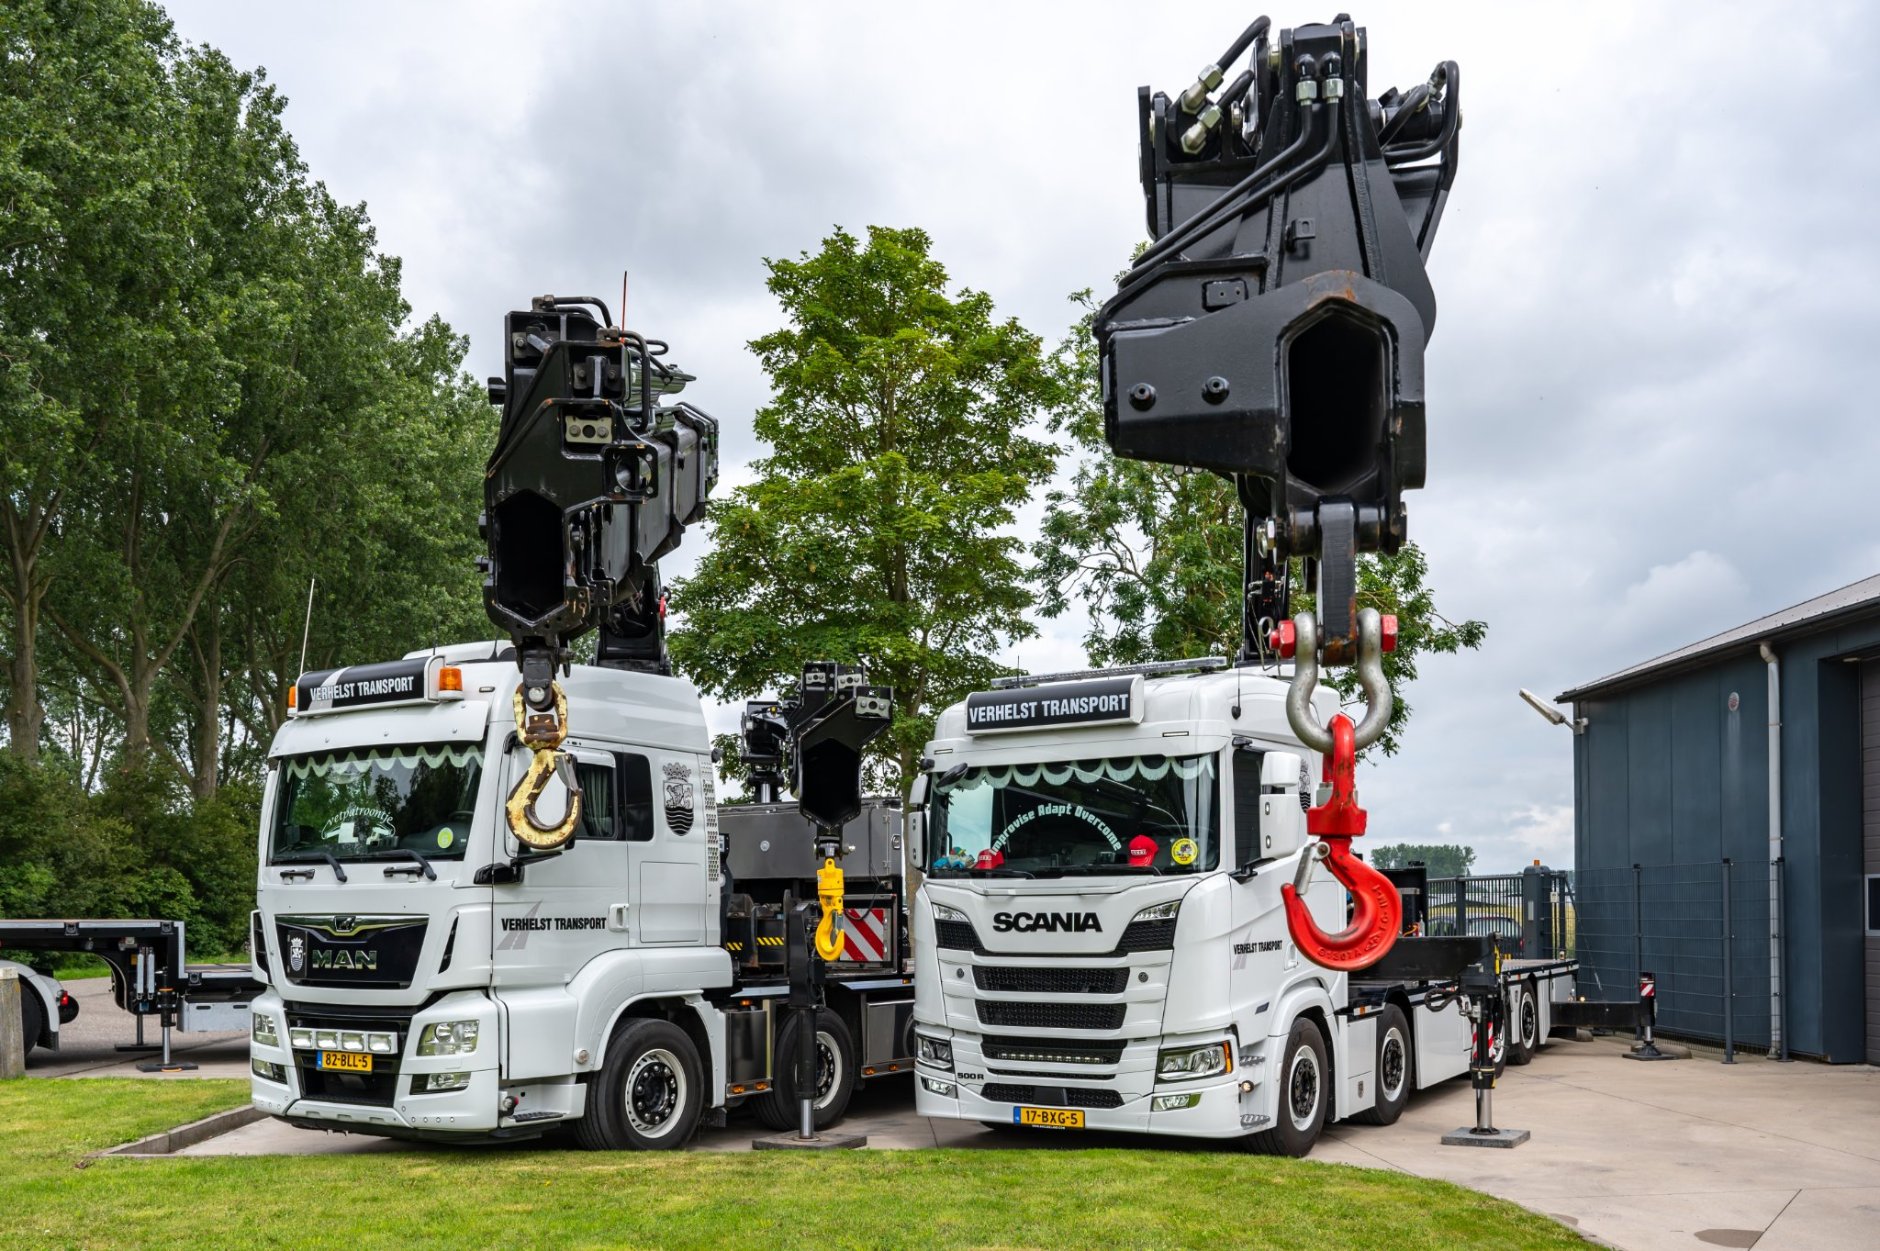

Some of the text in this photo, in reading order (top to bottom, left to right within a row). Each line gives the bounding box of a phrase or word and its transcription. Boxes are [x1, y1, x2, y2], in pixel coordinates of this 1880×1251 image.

[310, 676, 414, 701] VERHELST TRANSPORT
[969, 694, 1129, 723] VERHELST TRANSPORT
[989, 803, 1122, 856] Improvise Adapt Overcome
[501, 917, 607, 931] VERHELST TRANSPORT
[992, 912, 1103, 933] SCANIA
[1233, 940, 1283, 955] VERHELST TRANSPORT
[312, 949, 377, 969] MAN
[325, 1053, 368, 1069] 82-BLL-5
[1026, 1109, 1078, 1125] 17-BXG-5
